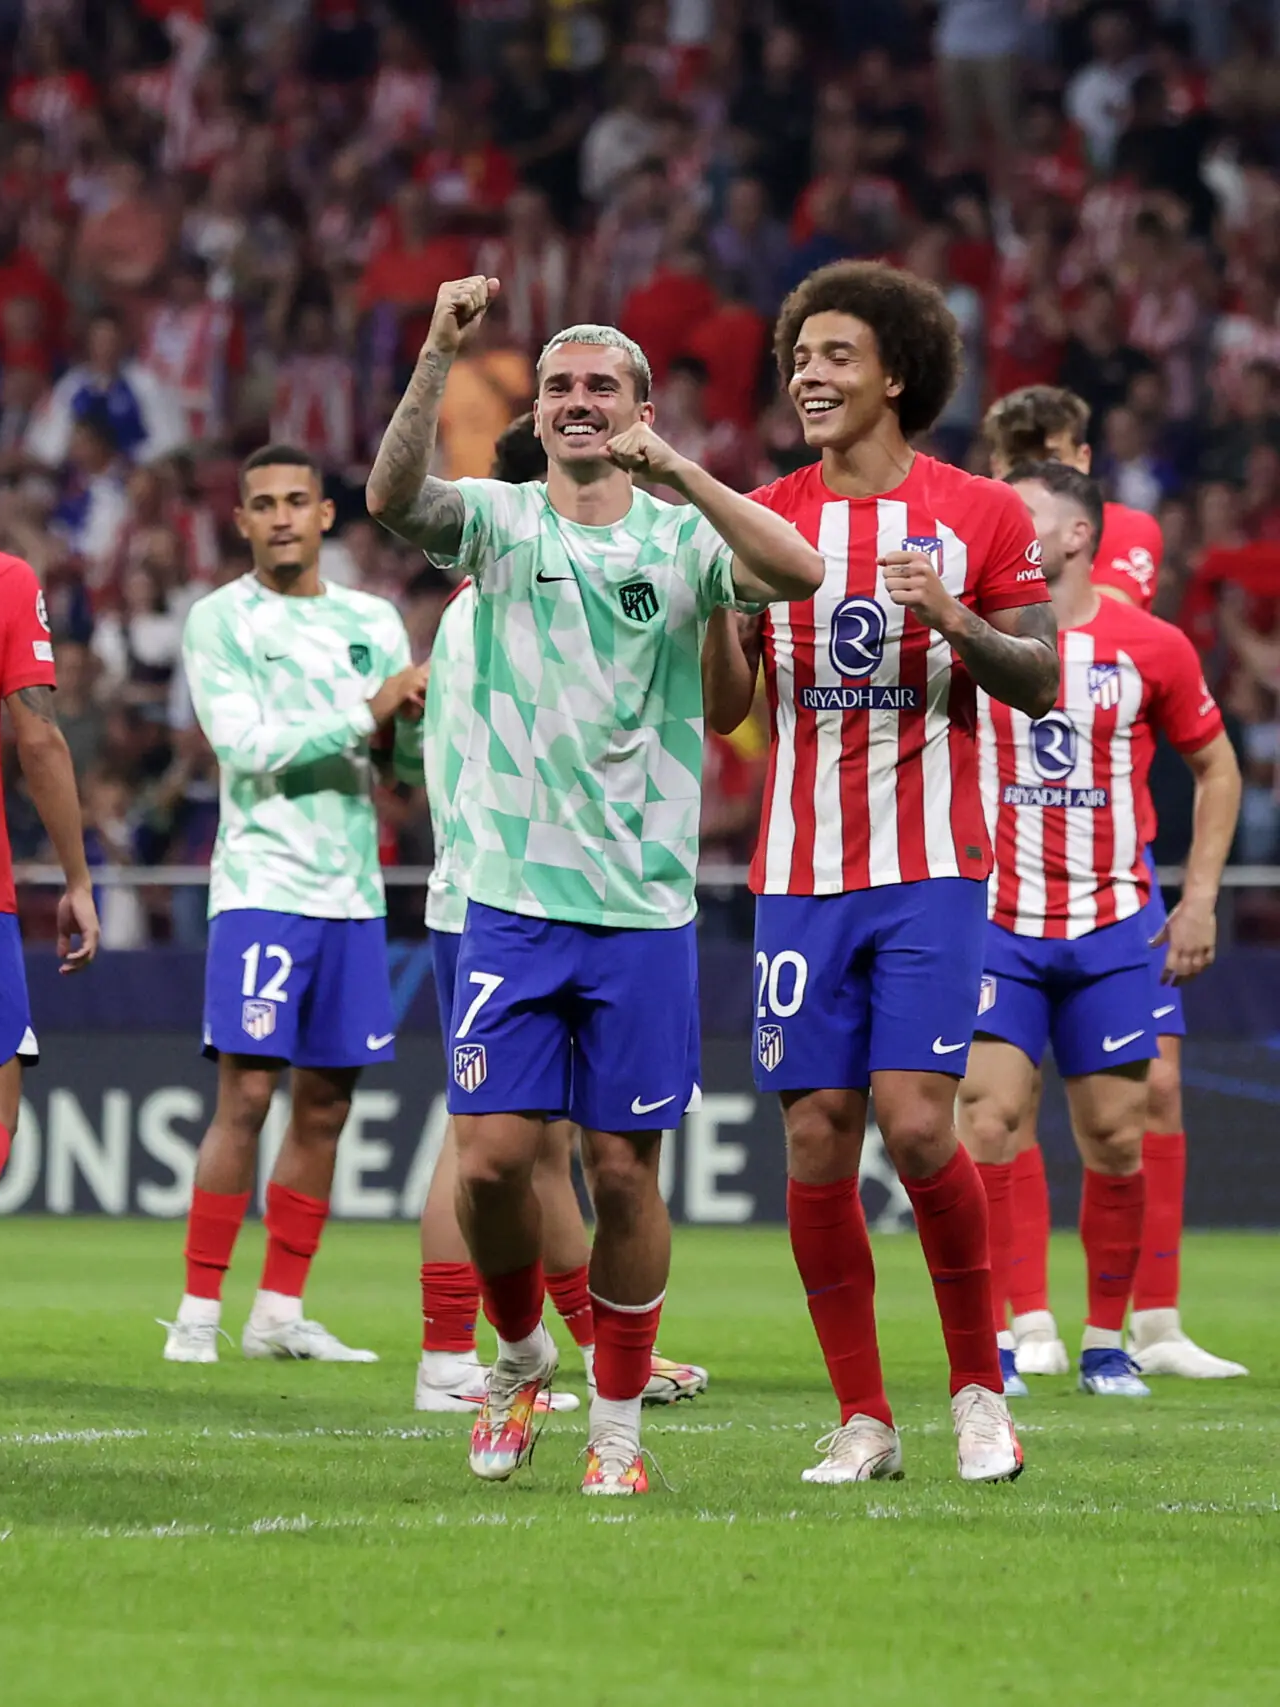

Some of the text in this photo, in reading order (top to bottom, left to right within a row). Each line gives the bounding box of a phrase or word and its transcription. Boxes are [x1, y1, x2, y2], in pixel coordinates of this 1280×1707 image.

[803, 688, 916, 708] RIYADH AIR
[1003, 786, 1106, 807] RIYADH AIR
[241, 942, 293, 1002] 12
[755, 950, 808, 1018] 20
[454, 970, 505, 1039] 7
